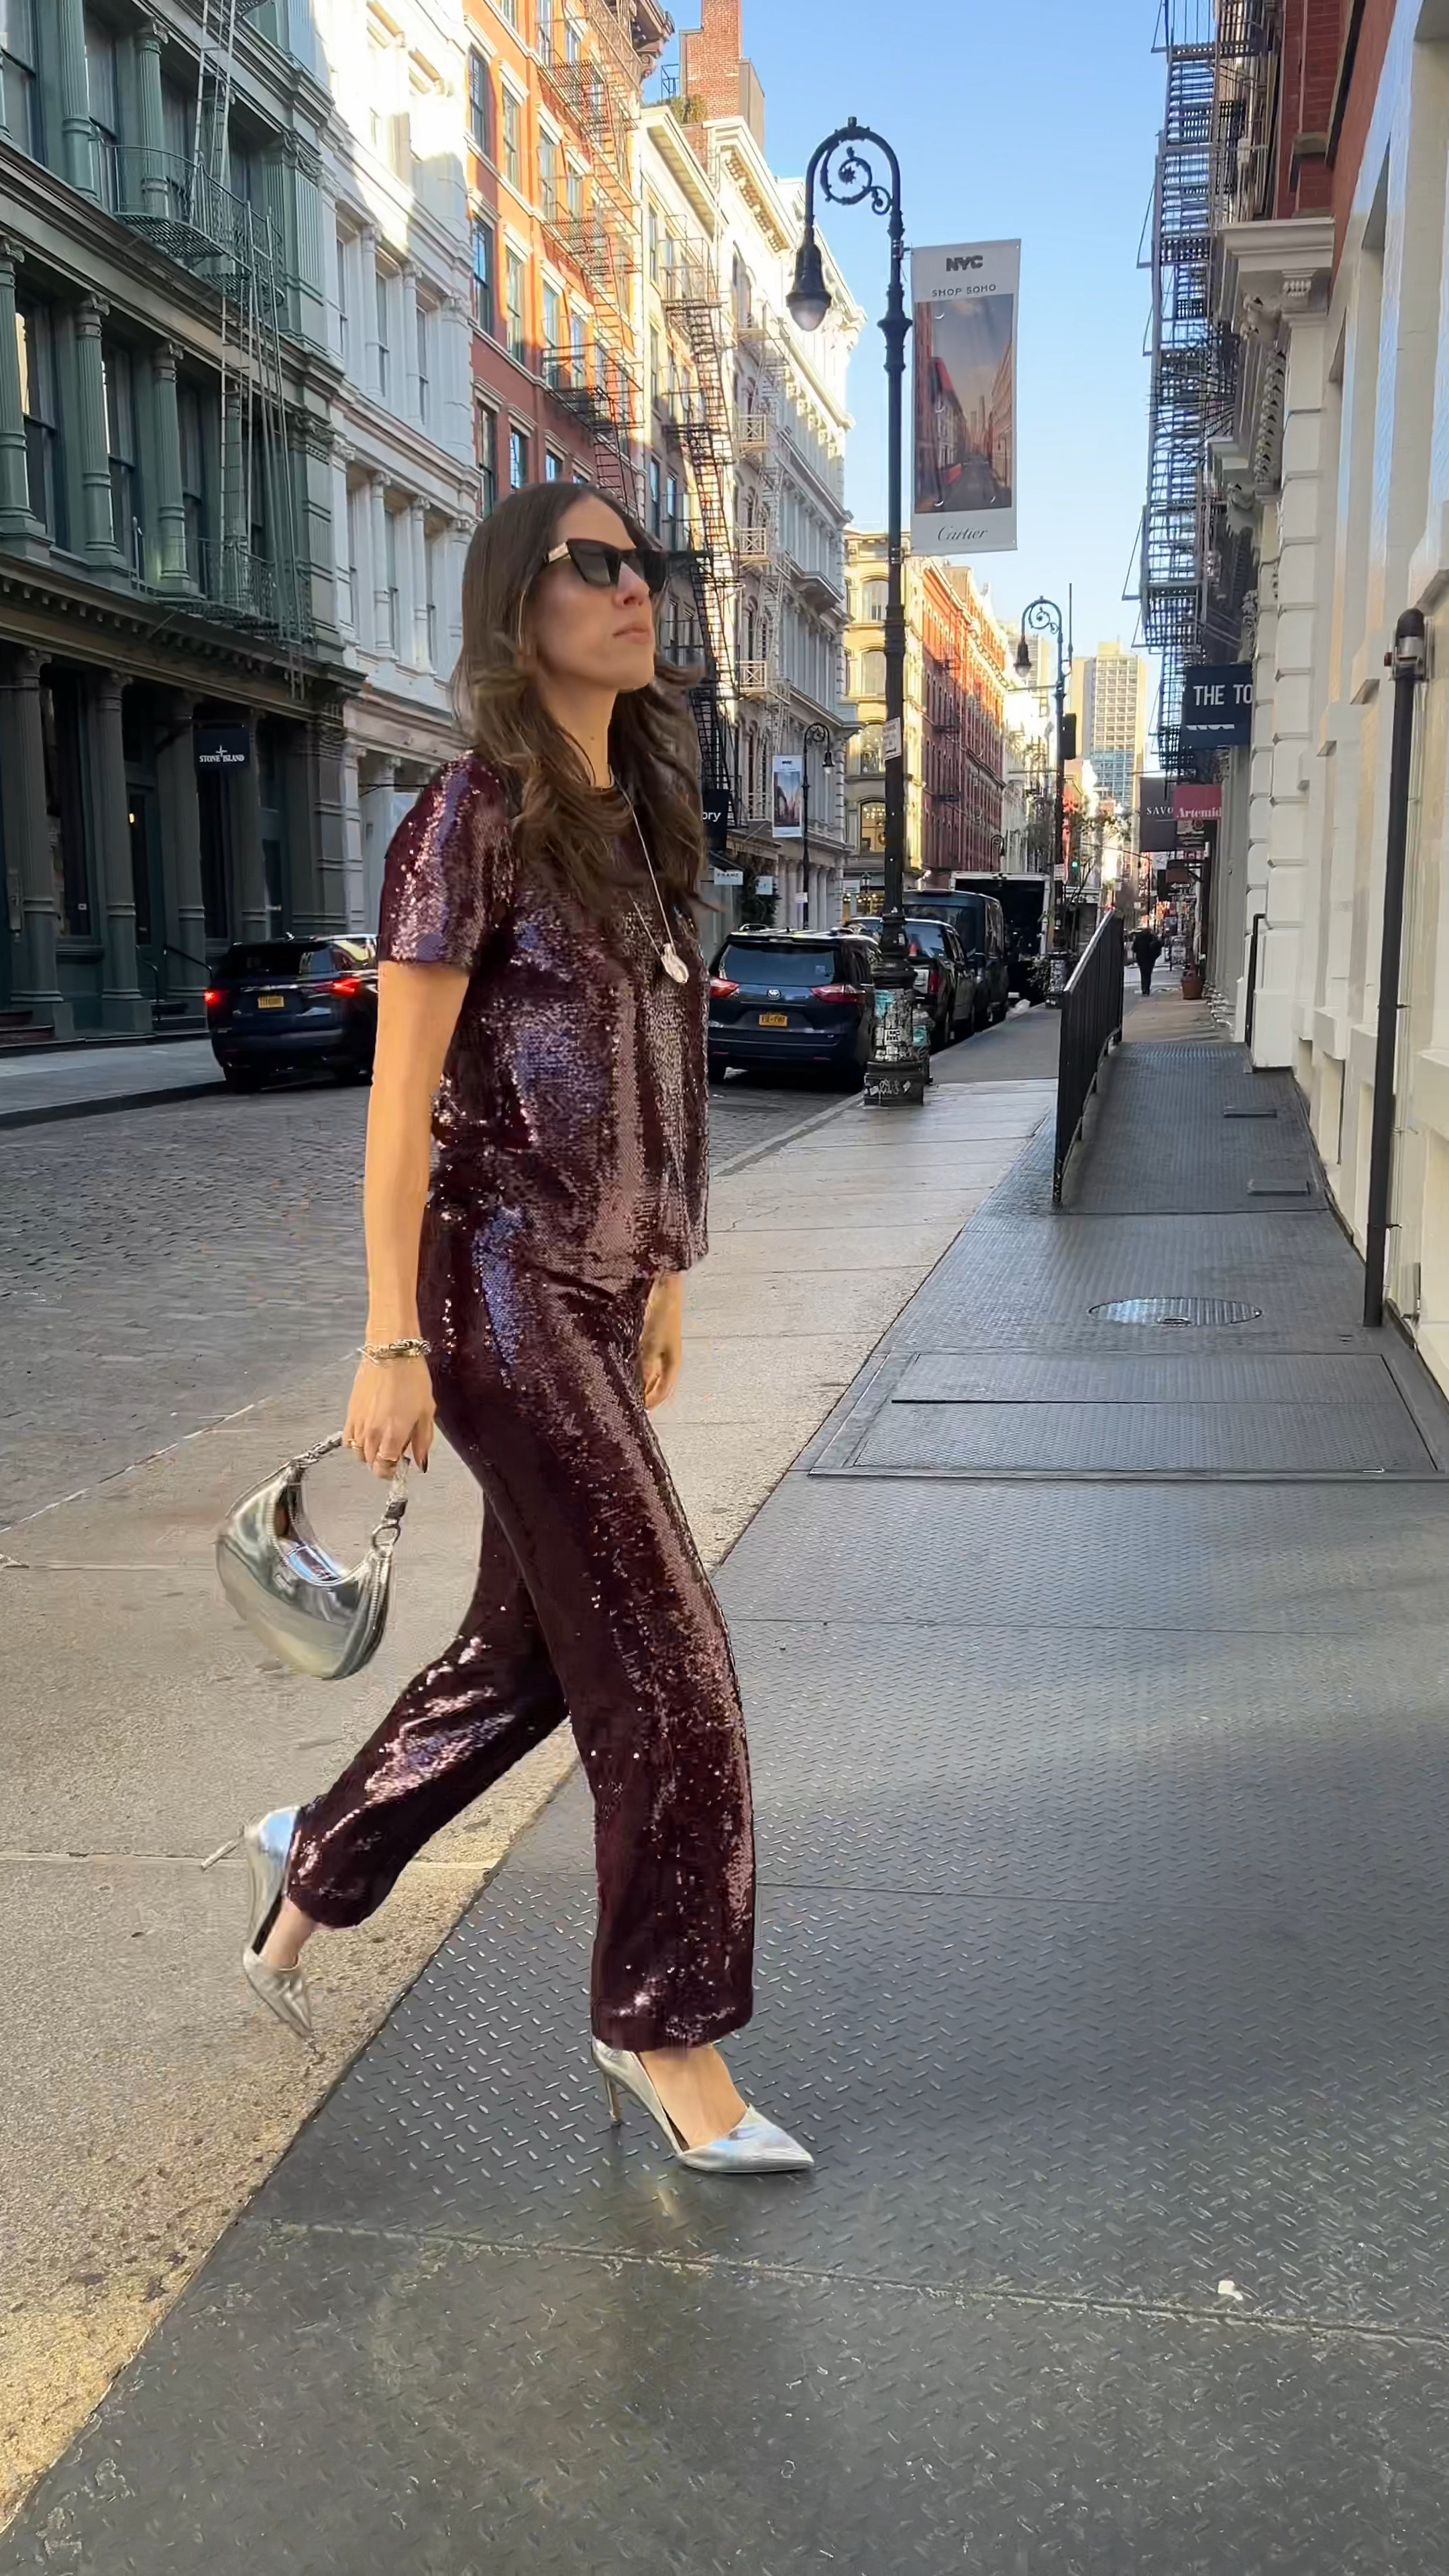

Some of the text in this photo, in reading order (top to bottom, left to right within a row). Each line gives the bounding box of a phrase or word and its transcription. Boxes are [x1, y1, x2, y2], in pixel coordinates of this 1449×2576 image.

[946, 255, 983, 272] NYC
[932, 284, 996, 297] SHOP SOHO
[938, 525, 988, 541] Cartier
[1193, 685, 1225, 706] THE
[223, 754, 245, 762] ISLAND
